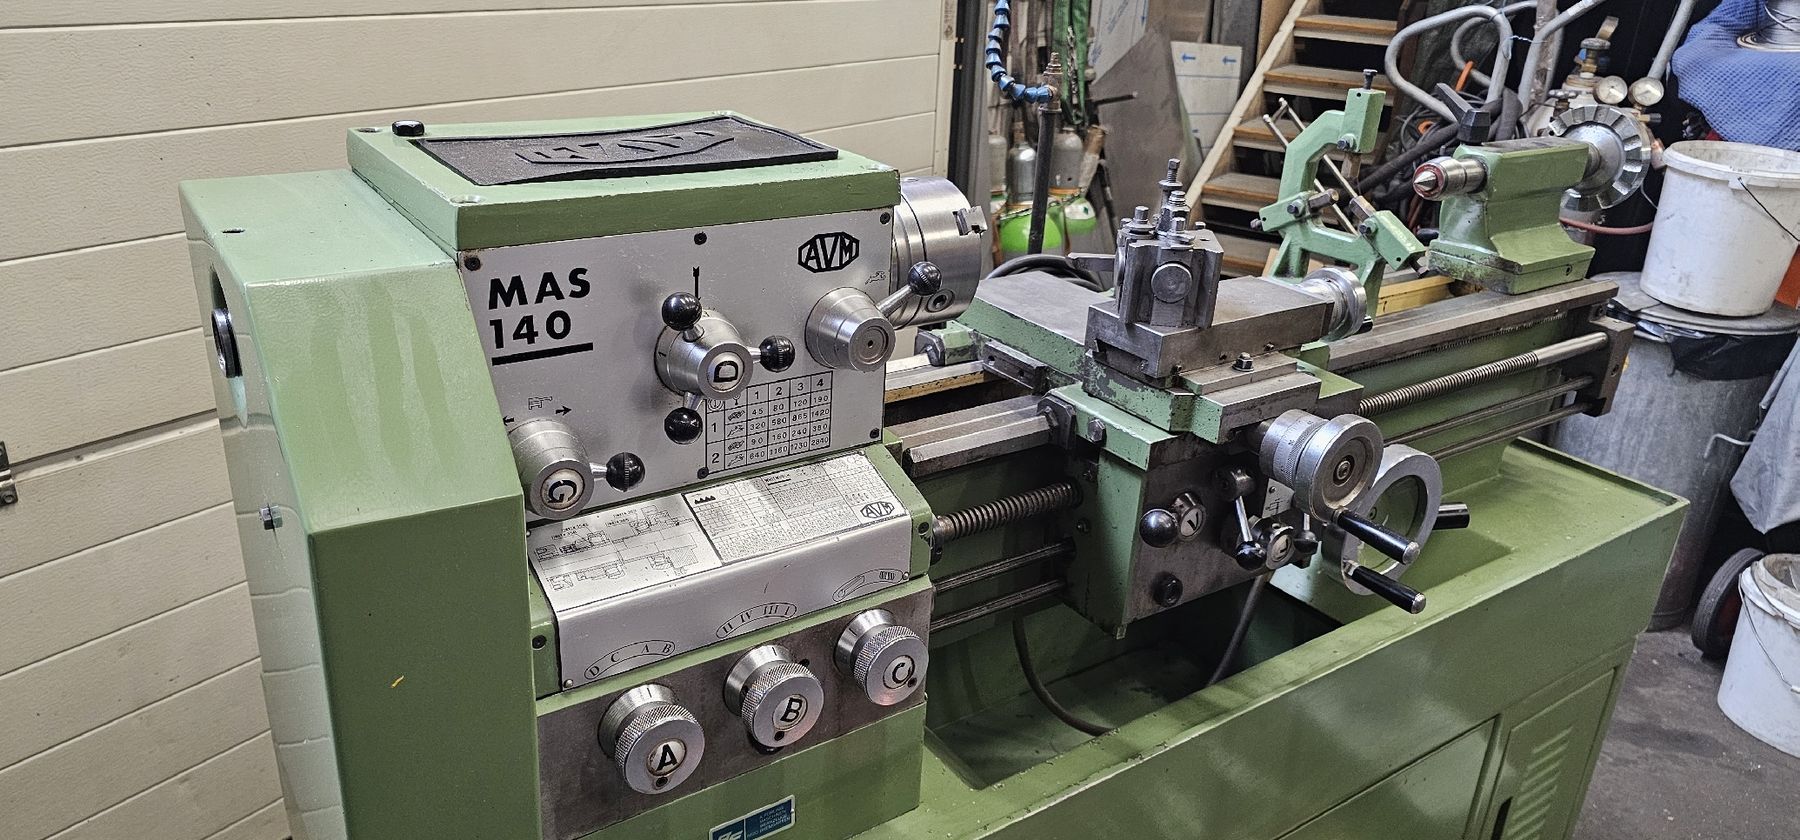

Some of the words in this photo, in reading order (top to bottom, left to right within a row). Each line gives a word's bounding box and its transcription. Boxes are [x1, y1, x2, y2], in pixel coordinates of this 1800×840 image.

[799, 232, 860, 273] AVM
[488, 267, 591, 310] MAS
[489, 310, 572, 349] 140
[713, 360, 739, 383] D
[754, 391, 760, 400] 1
[775, 386, 783, 396] 2
[797, 382, 804, 391] 3
[816, 378, 824, 387] 4
[751, 407, 764, 415] 45
[772, 403, 784, 412] 80
[793, 399, 808, 408] 120
[813, 395, 829, 404] 190
[711, 422, 717, 432] 1
[749, 421, 766, 431] 320
[771, 417, 787, 426] 580
[811, 408, 830, 418] 1420
[751, 437, 764, 446] 90
[772, 432, 787, 441] 160
[791, 427, 807, 438] 240
[711, 452, 720, 464] 2
[749, 451, 766, 460] 640
[769, 445, 788, 456] 1160
[548, 479, 578, 503] G
[860, 501, 895, 518] AVM
[722, 622, 733, 634] II
[739, 611, 752, 623] IV
[763, 605, 779, 615] III
[588, 664, 601, 677] D
[610, 651, 620, 663] C
[641, 643, 650, 654] A
[662, 643, 672, 654] B
[891, 661, 911, 685] C
[780, 697, 803, 723] B
[655, 743, 679, 772] A
